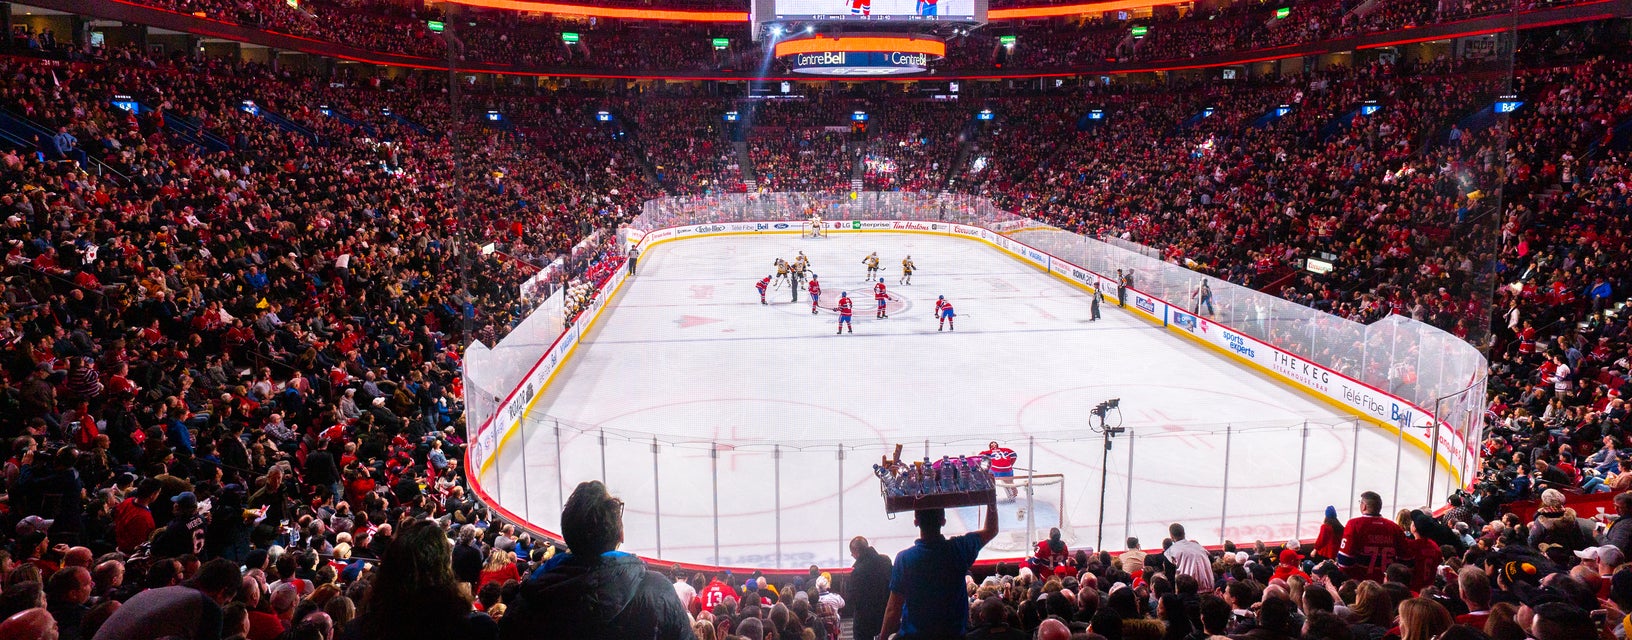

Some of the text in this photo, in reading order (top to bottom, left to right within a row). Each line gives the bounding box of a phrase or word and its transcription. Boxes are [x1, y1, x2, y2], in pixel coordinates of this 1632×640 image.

[797, 51, 845, 66] CentreBell
[1223, 331, 1244, 345] sports
[1229, 341, 1255, 358] experts
[1273, 350, 1329, 384] THE KEG
[1341, 384, 1361, 405] Télé
[1362, 394, 1385, 416] Fibe
[192, 528, 205, 554] 6
[706, 591, 723, 607] 13
